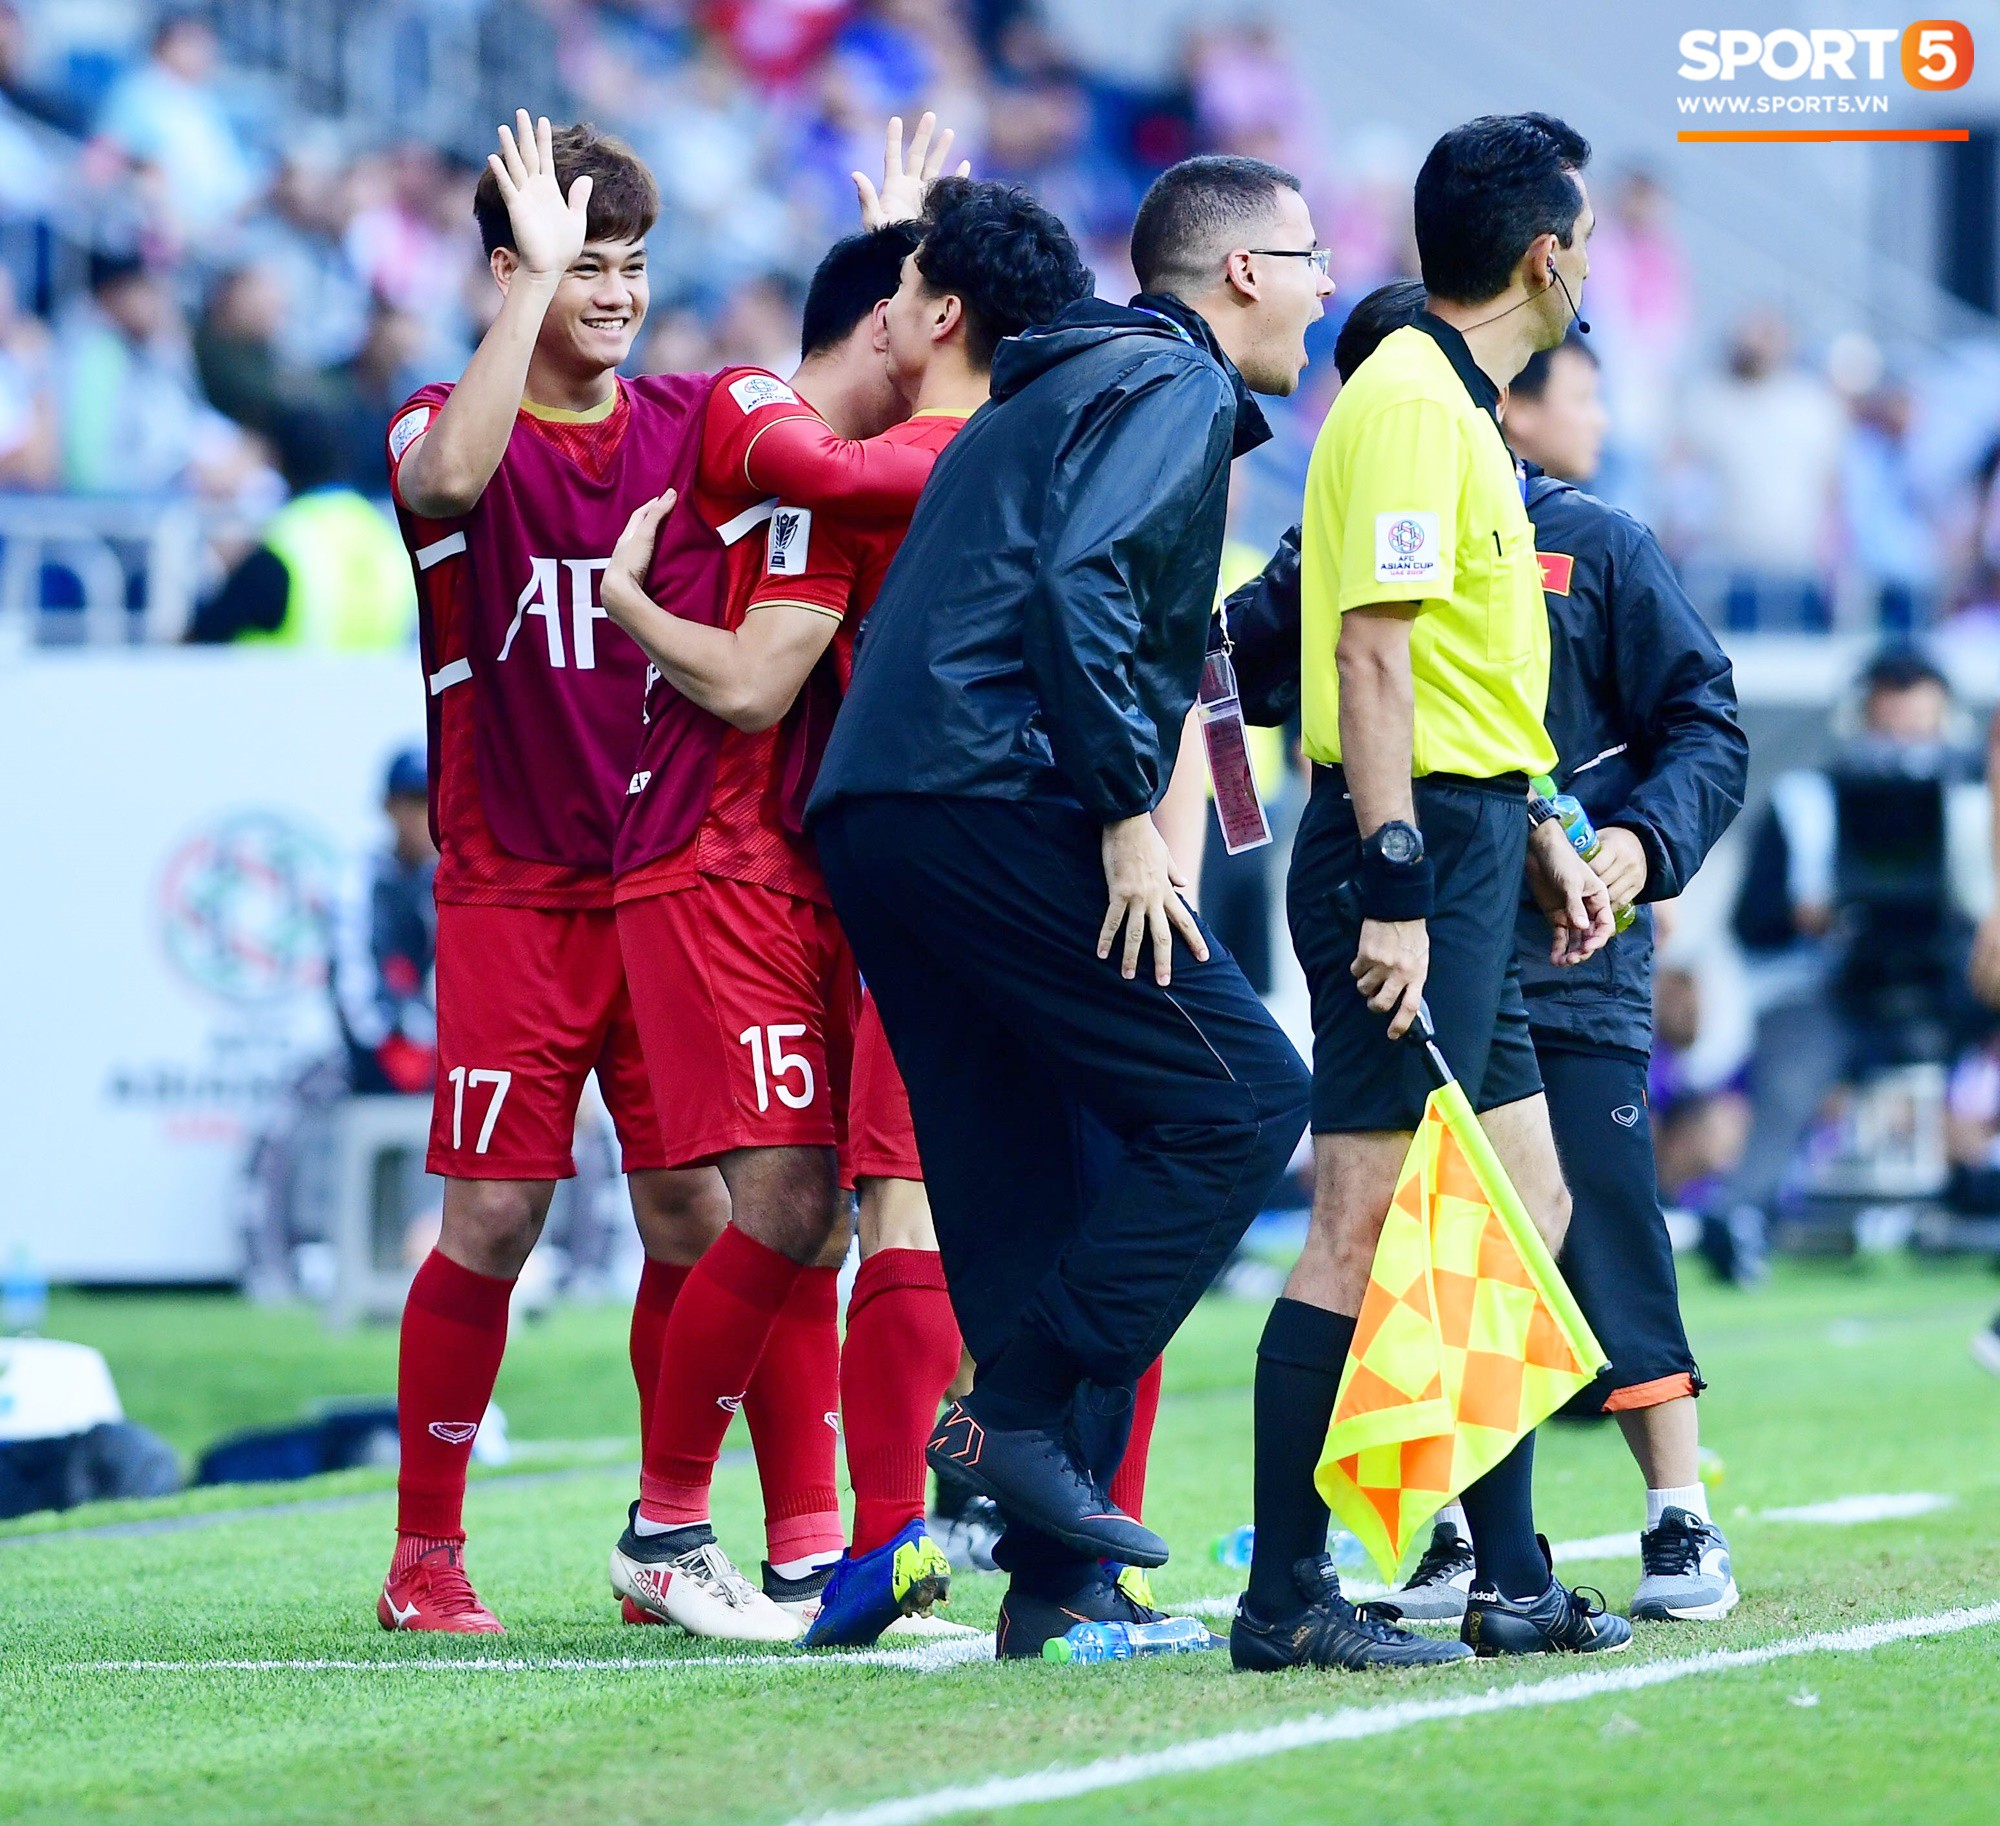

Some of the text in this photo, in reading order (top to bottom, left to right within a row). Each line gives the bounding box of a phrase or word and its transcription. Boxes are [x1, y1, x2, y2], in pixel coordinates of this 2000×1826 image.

[1381, 562, 1410, 570] ASIAN
[739, 1024, 814, 1112] 15
[448, 1066, 511, 1154] 17
[635, 1571, 669, 1615] adidas
